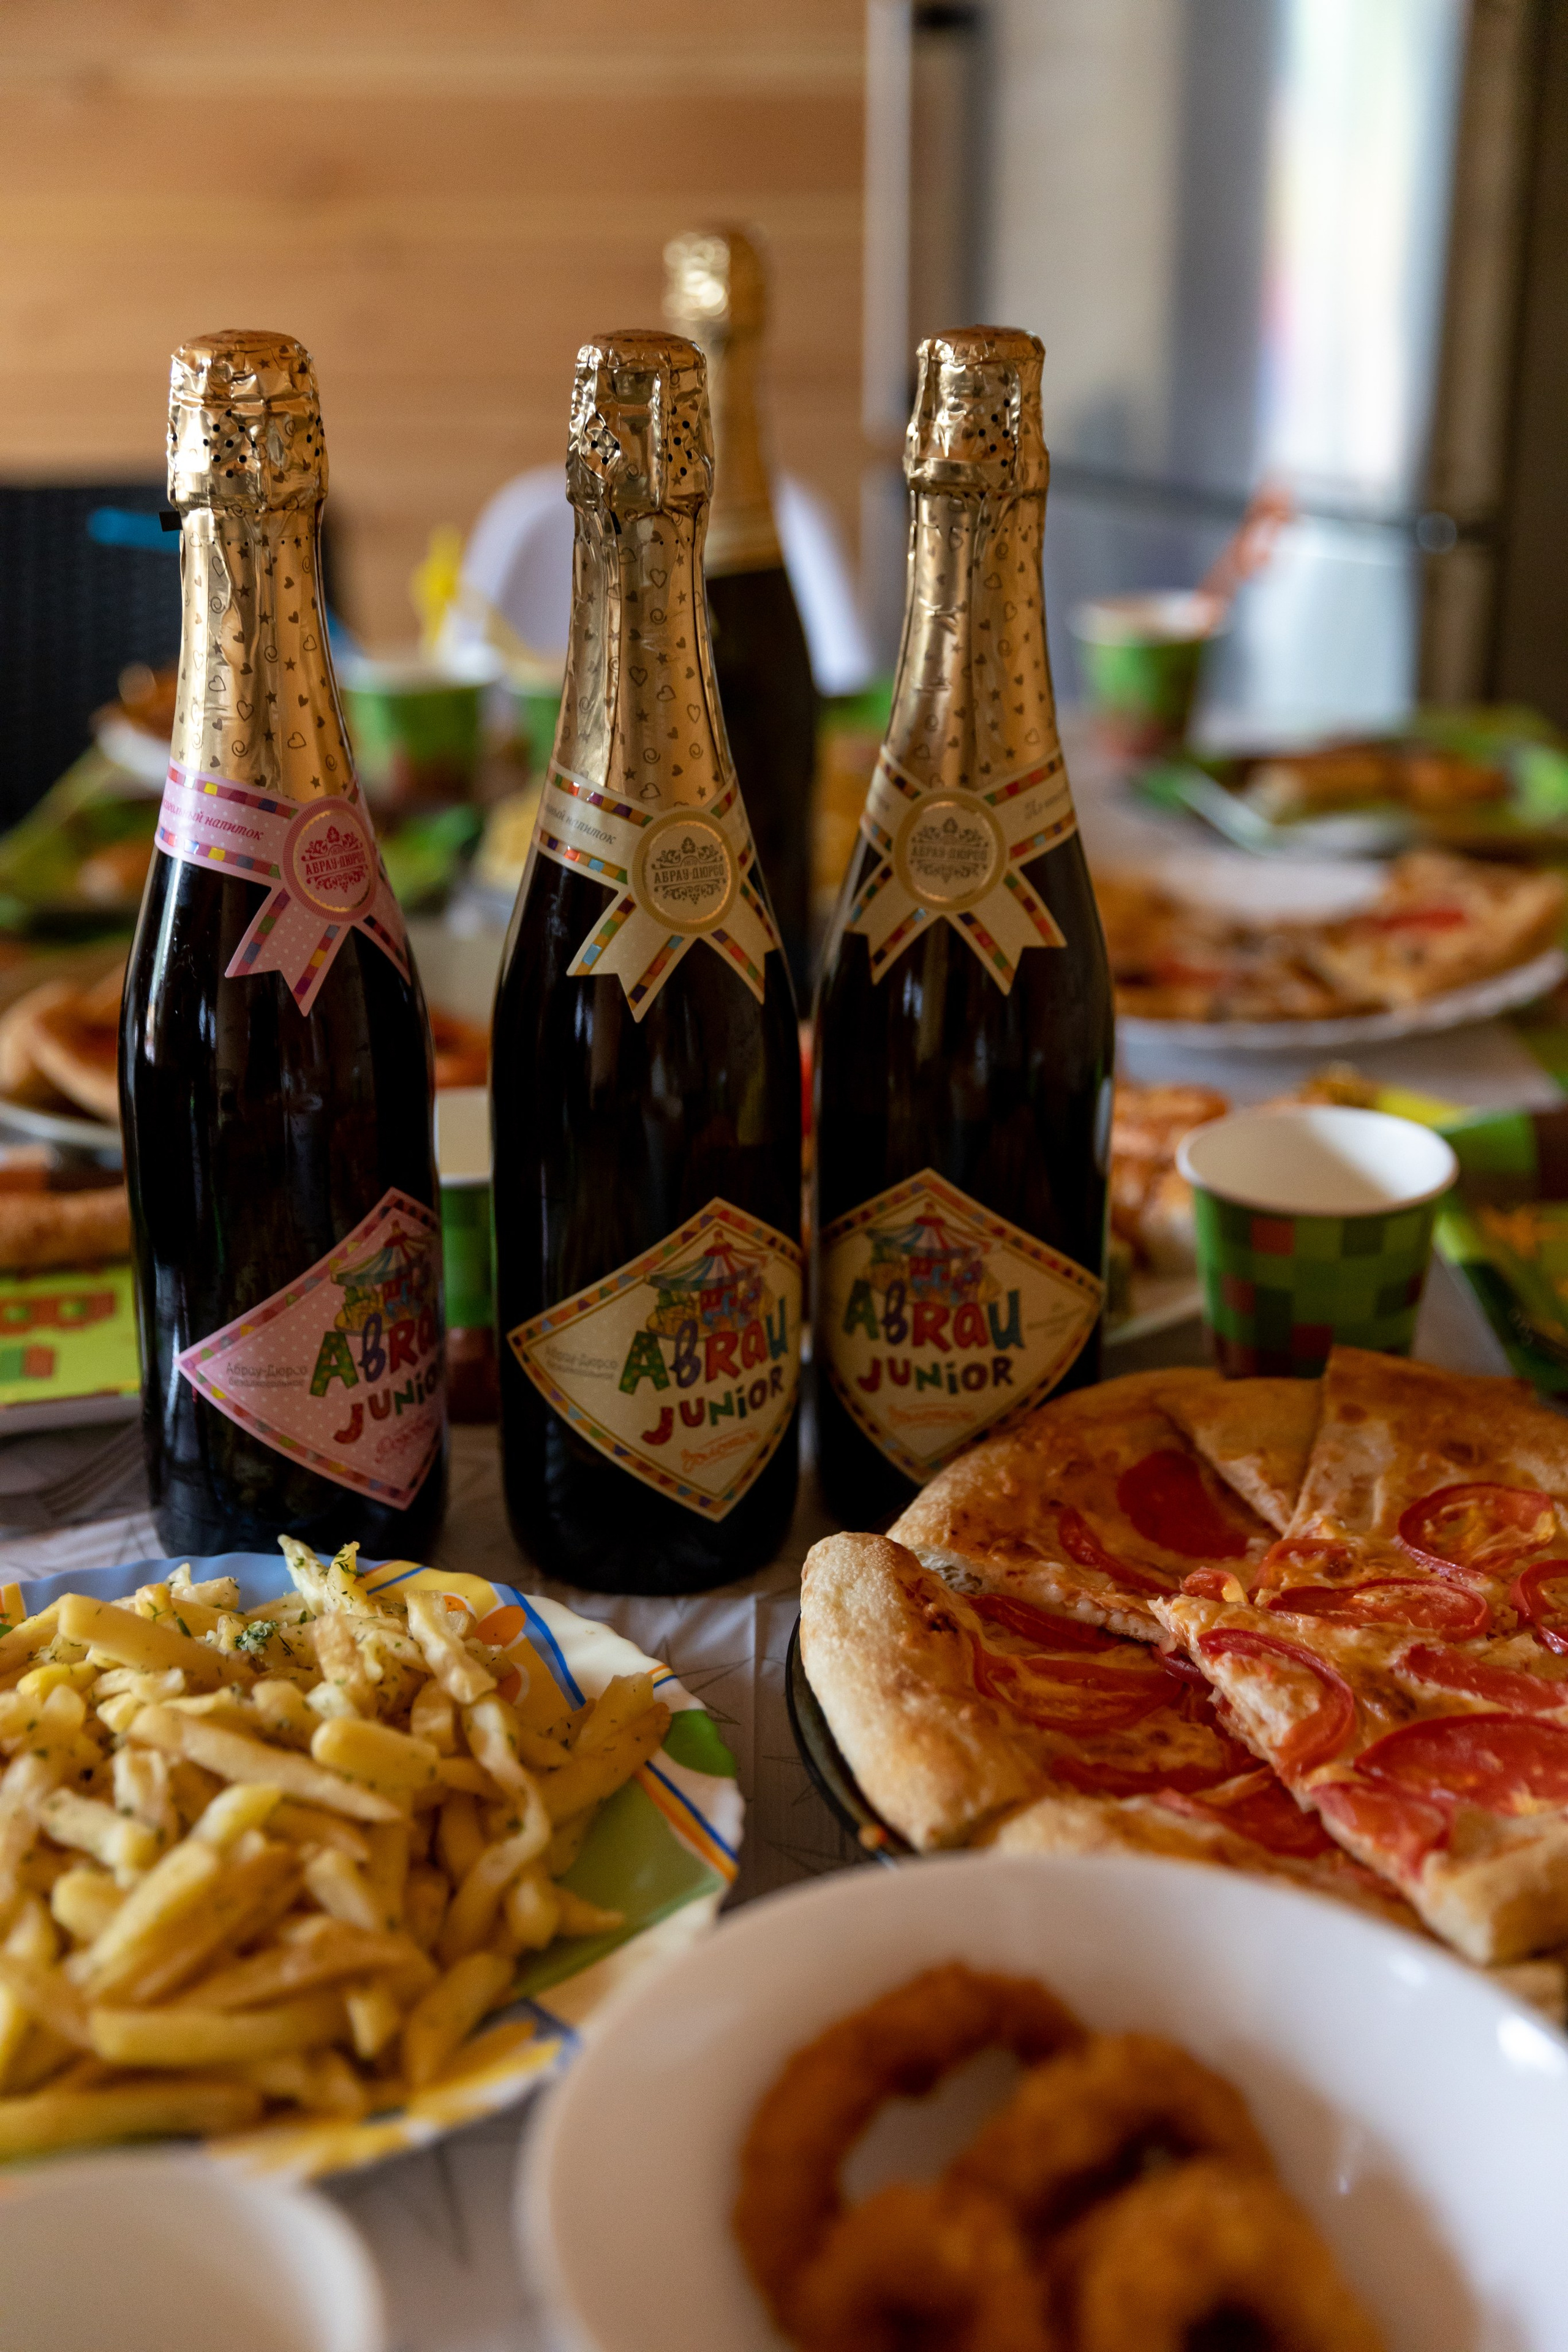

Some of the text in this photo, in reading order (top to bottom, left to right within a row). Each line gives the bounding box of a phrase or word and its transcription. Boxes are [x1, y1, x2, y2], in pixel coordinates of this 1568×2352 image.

[205, 815, 264, 840] напиток
[566, 816, 616, 845] напиток
[309, 1304, 442, 1398] ABRA
[619, 1295, 790, 1395] ABRAU
[843, 1278, 1025, 1352] ABRAU
